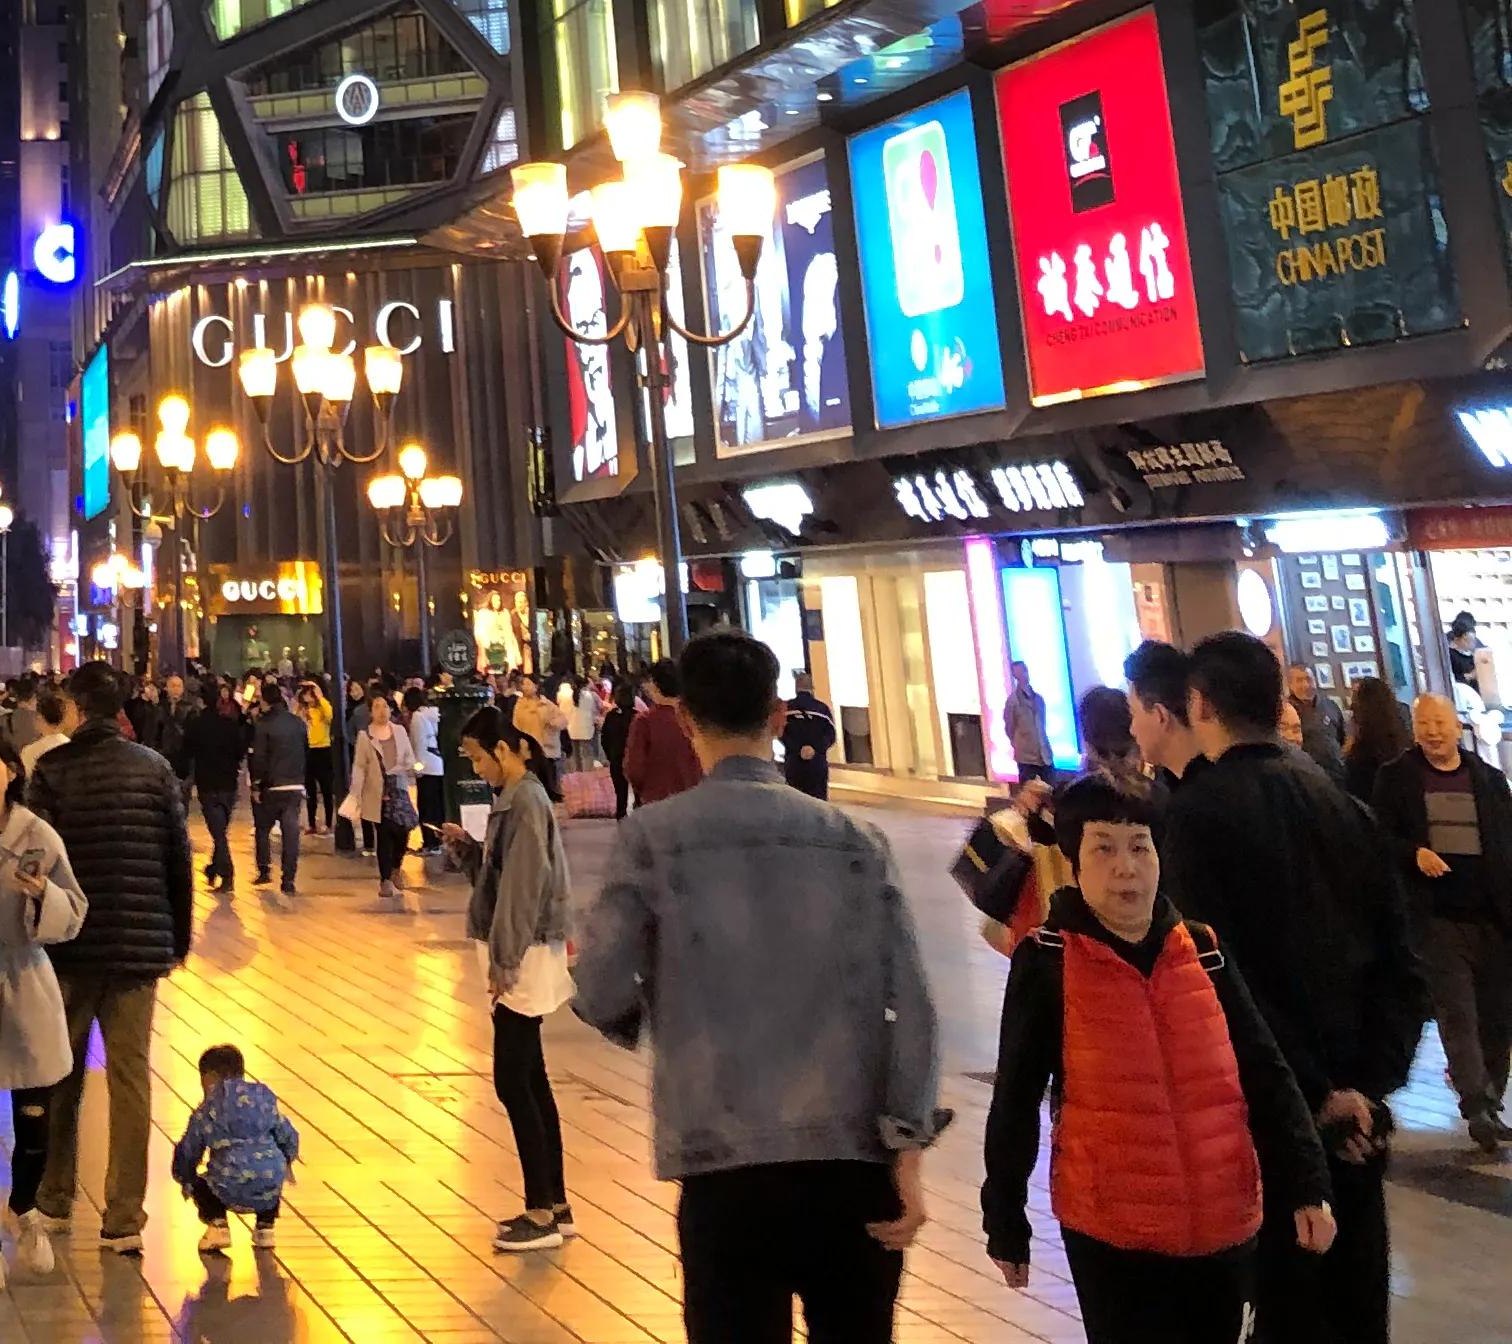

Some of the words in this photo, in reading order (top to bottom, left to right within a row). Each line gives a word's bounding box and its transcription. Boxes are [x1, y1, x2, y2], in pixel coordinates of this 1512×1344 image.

[1268, 164, 1384, 240] 中国邮政
[1275, 240, 1339, 286] CHINA
[1336, 227, 1387, 274] POST
[192, 299, 455, 368] GUCCI
[222, 577, 306, 602] GUCCI
[480, 571, 527, 584] GUCCI
